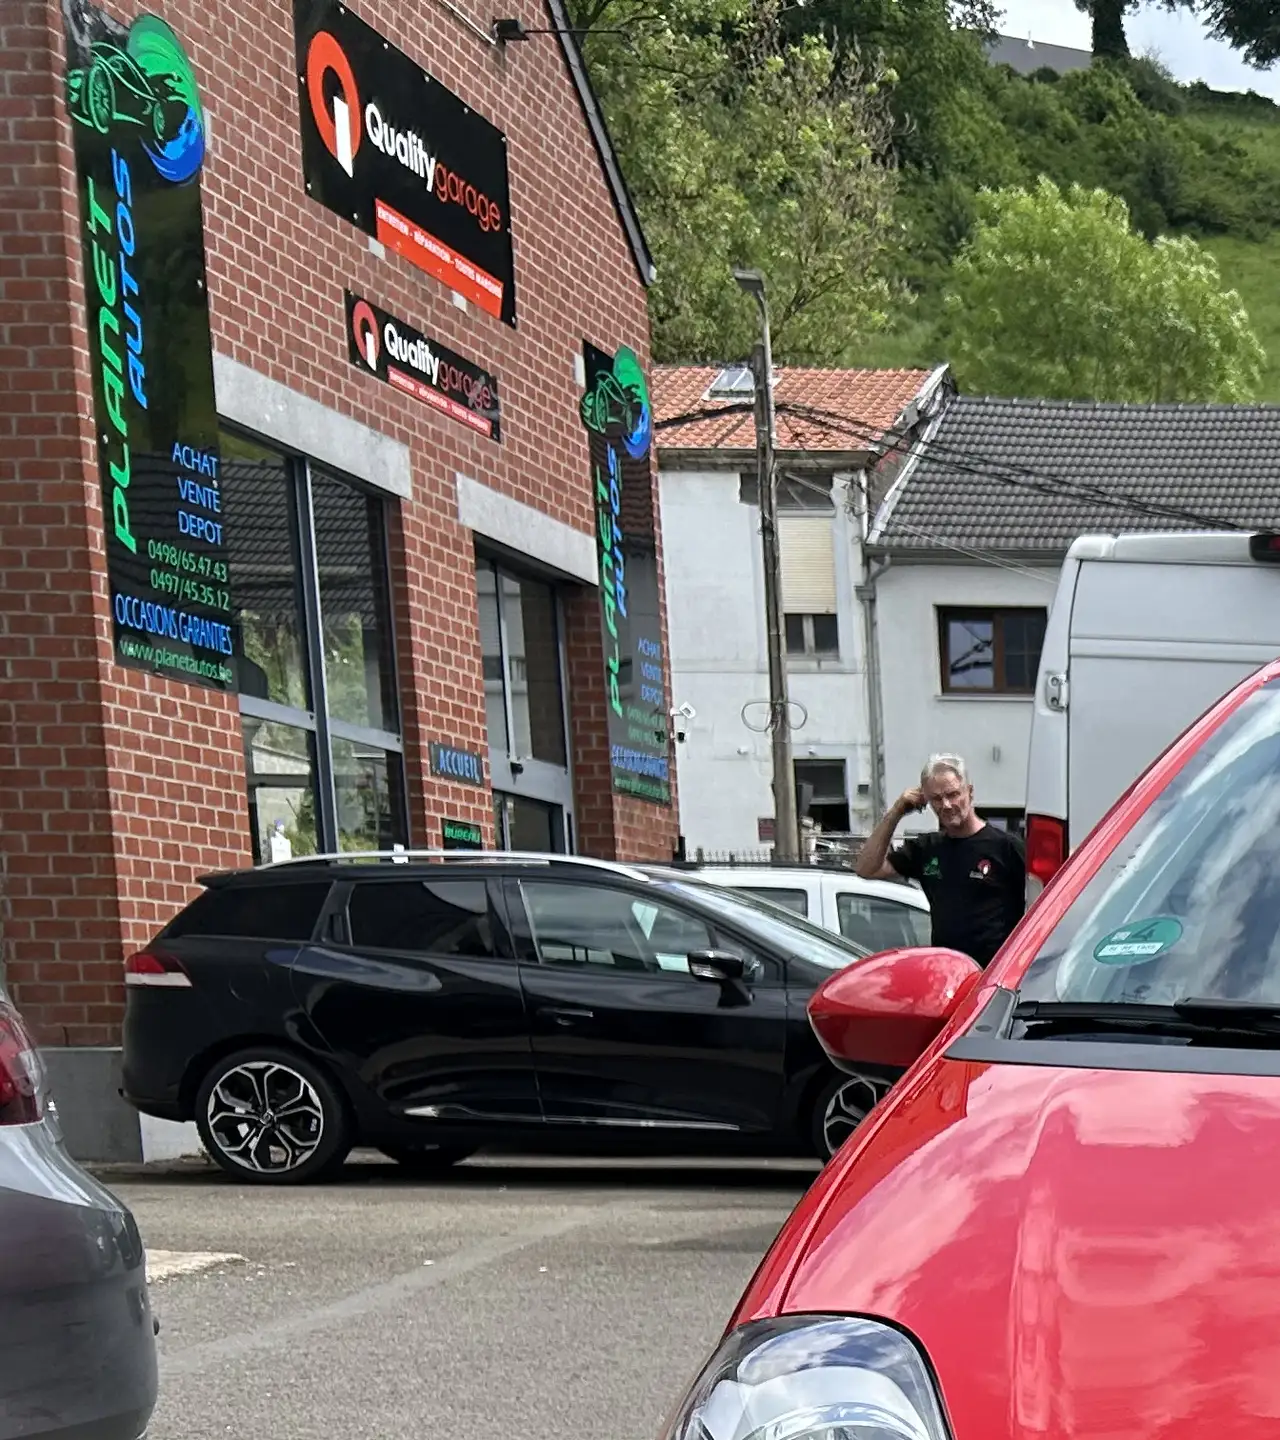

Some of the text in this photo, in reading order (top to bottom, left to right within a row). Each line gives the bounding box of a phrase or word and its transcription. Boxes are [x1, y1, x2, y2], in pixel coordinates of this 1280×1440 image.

[111, 147, 148, 410] AUTOS
[87, 175, 137, 555] PLANET
[172, 442, 218, 479] ACHAT
[177, 476, 221, 514] VENTE
[178, 511, 223, 546] DEPOT
[607, 442, 627, 618] AUTOS
[148, 539, 228, 583] 0498/65.47.43
[150, 569, 230, 611] 0497/45.35.12
[597, 465, 623, 718] PLANET
[115, 594, 233, 656] OCCASIONS GARANTIES
[119, 640, 233, 684] www.planetautos.be
[439, 748, 481, 784] ACCUEIL
[444, 823, 481, 845] BUREAU
